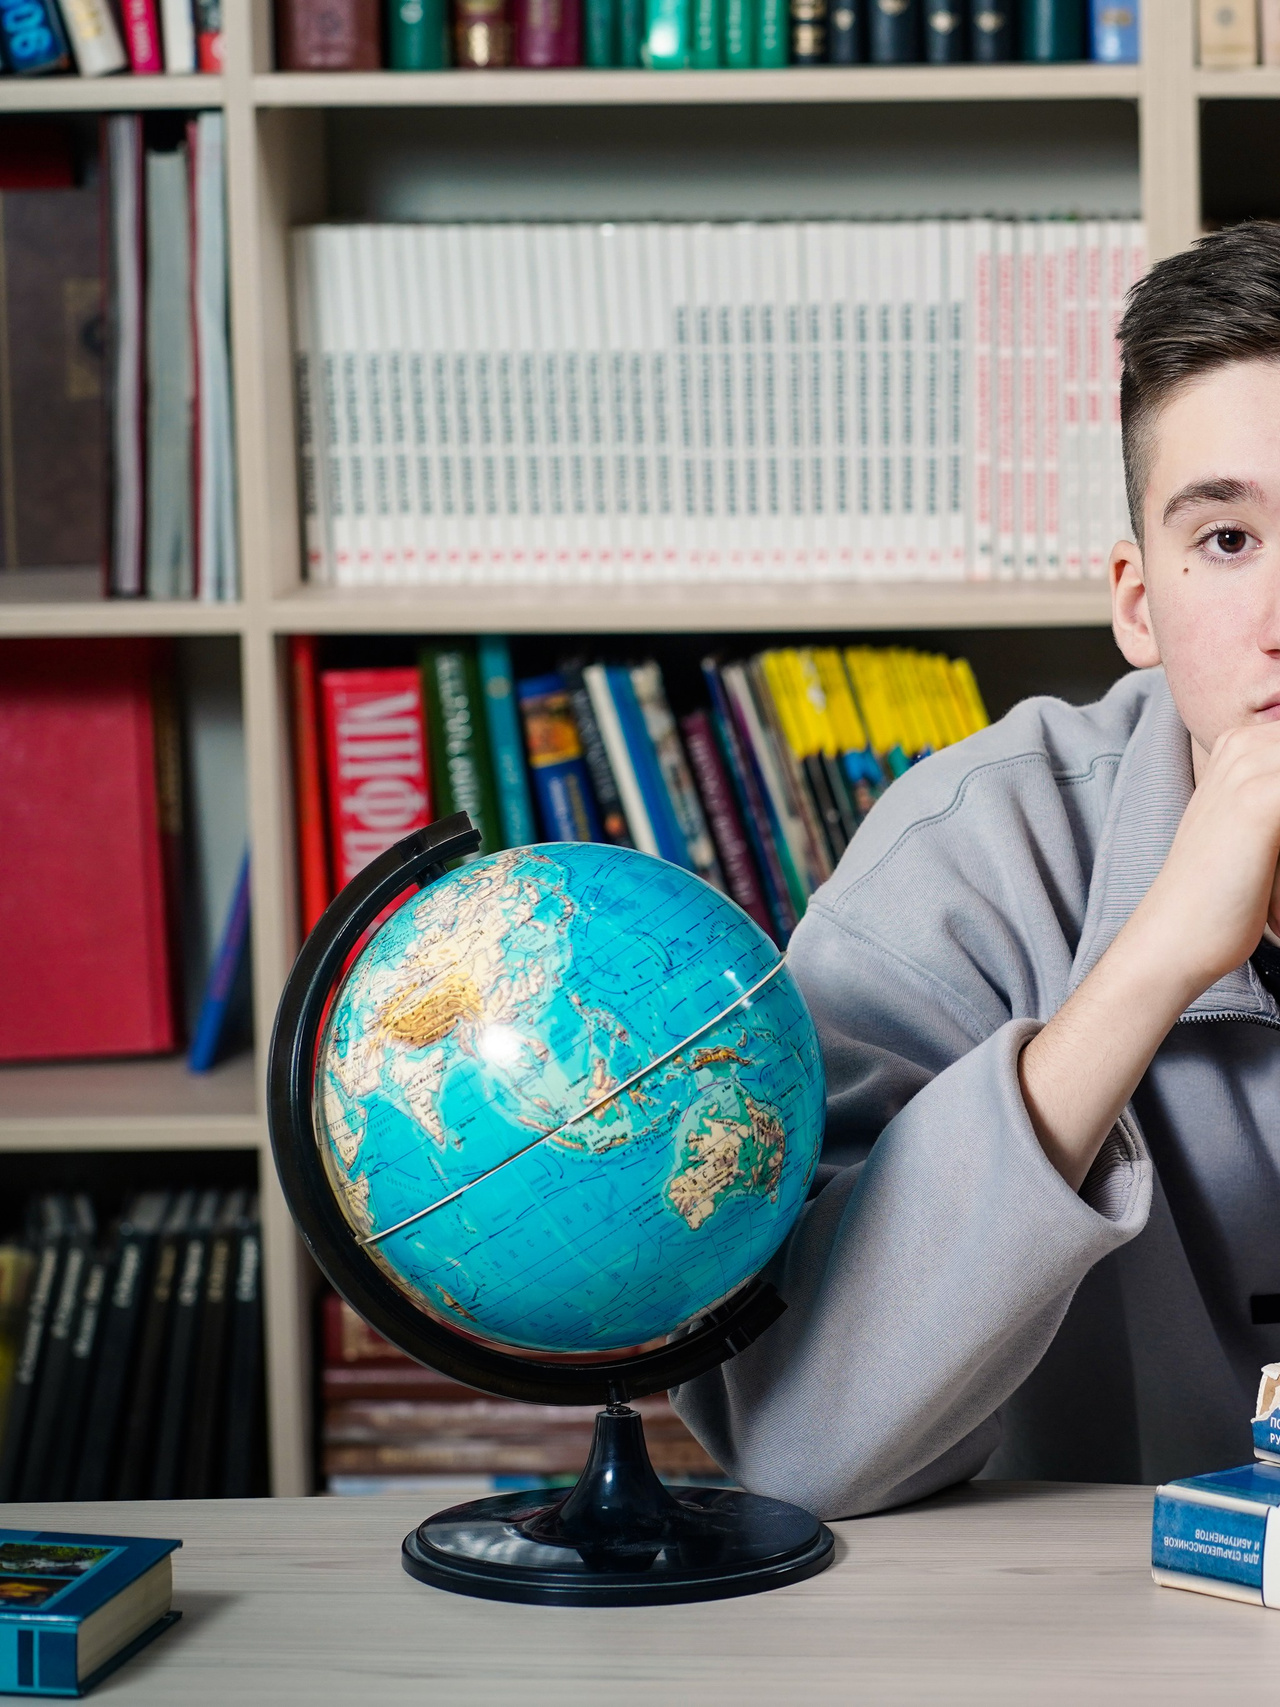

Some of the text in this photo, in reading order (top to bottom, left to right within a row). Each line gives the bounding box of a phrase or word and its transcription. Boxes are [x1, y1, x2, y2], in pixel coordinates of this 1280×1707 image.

[1163, 1536, 1260, 1565] ДЛЯ СТАРШЕКЛАССНИКОВ
[1194, 1529, 1260, 1551] И АБИТУРИЕНТОВ
